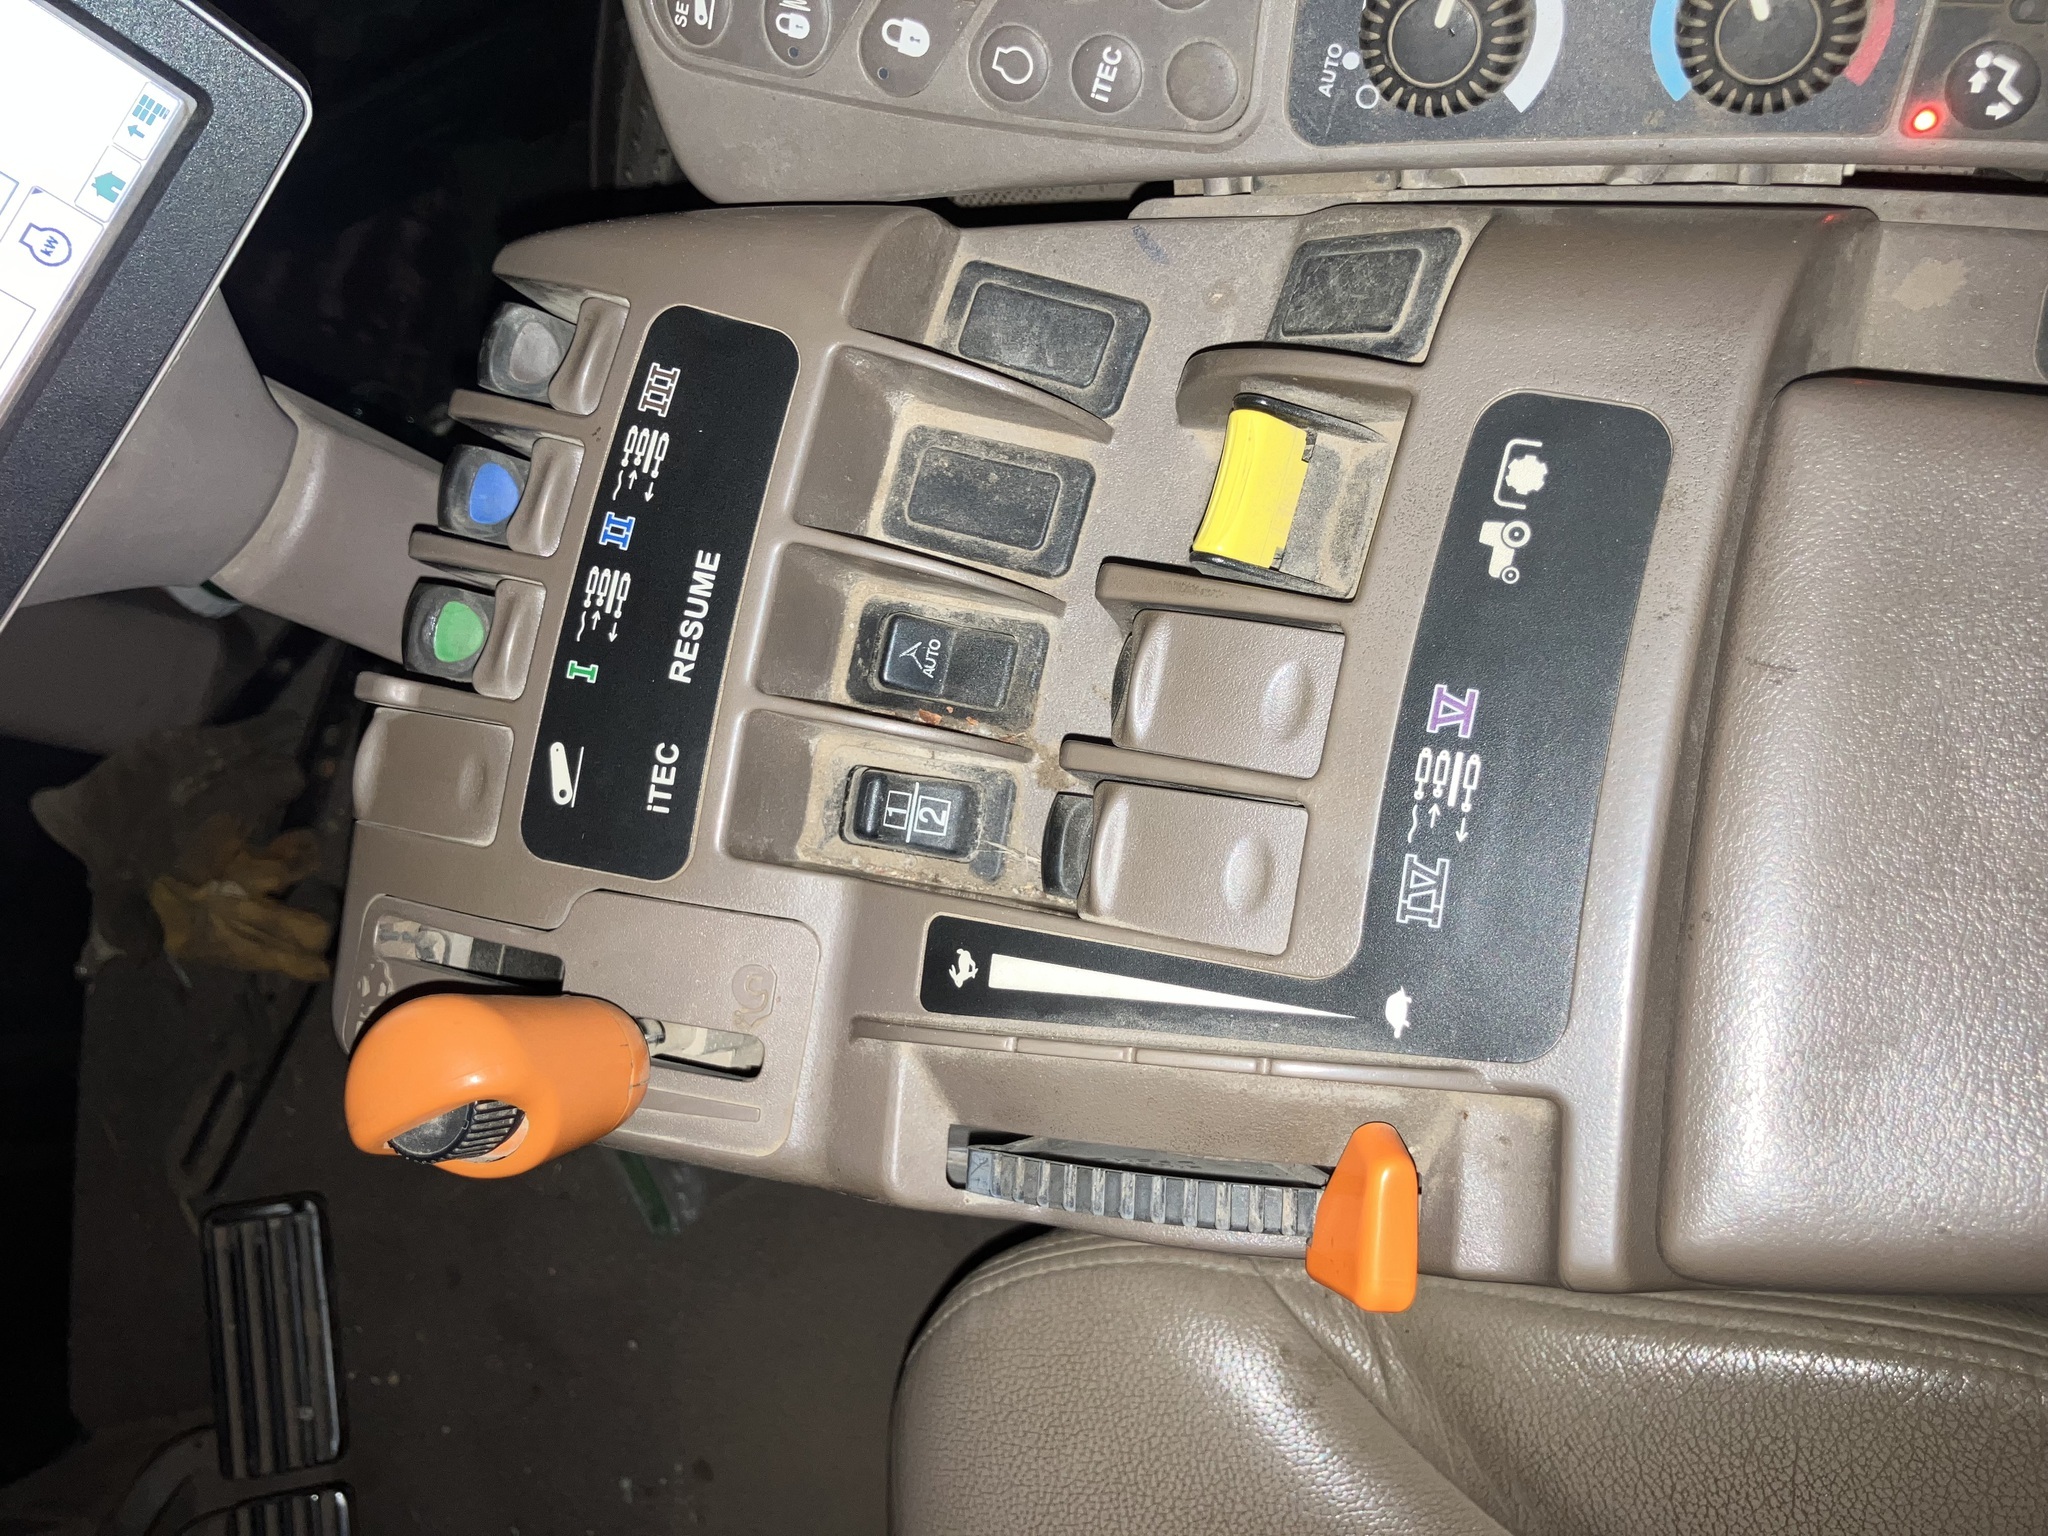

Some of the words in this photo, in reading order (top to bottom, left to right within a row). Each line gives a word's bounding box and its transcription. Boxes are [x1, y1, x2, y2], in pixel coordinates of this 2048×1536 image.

[1090, 46, 1122, 103] iTEC
[1318, 43, 1343, 98] AUTO
[669, 549, 721, 683] RESUME
[922, 638, 942, 679] AUTO
[647, 742, 680, 813] iTEC
